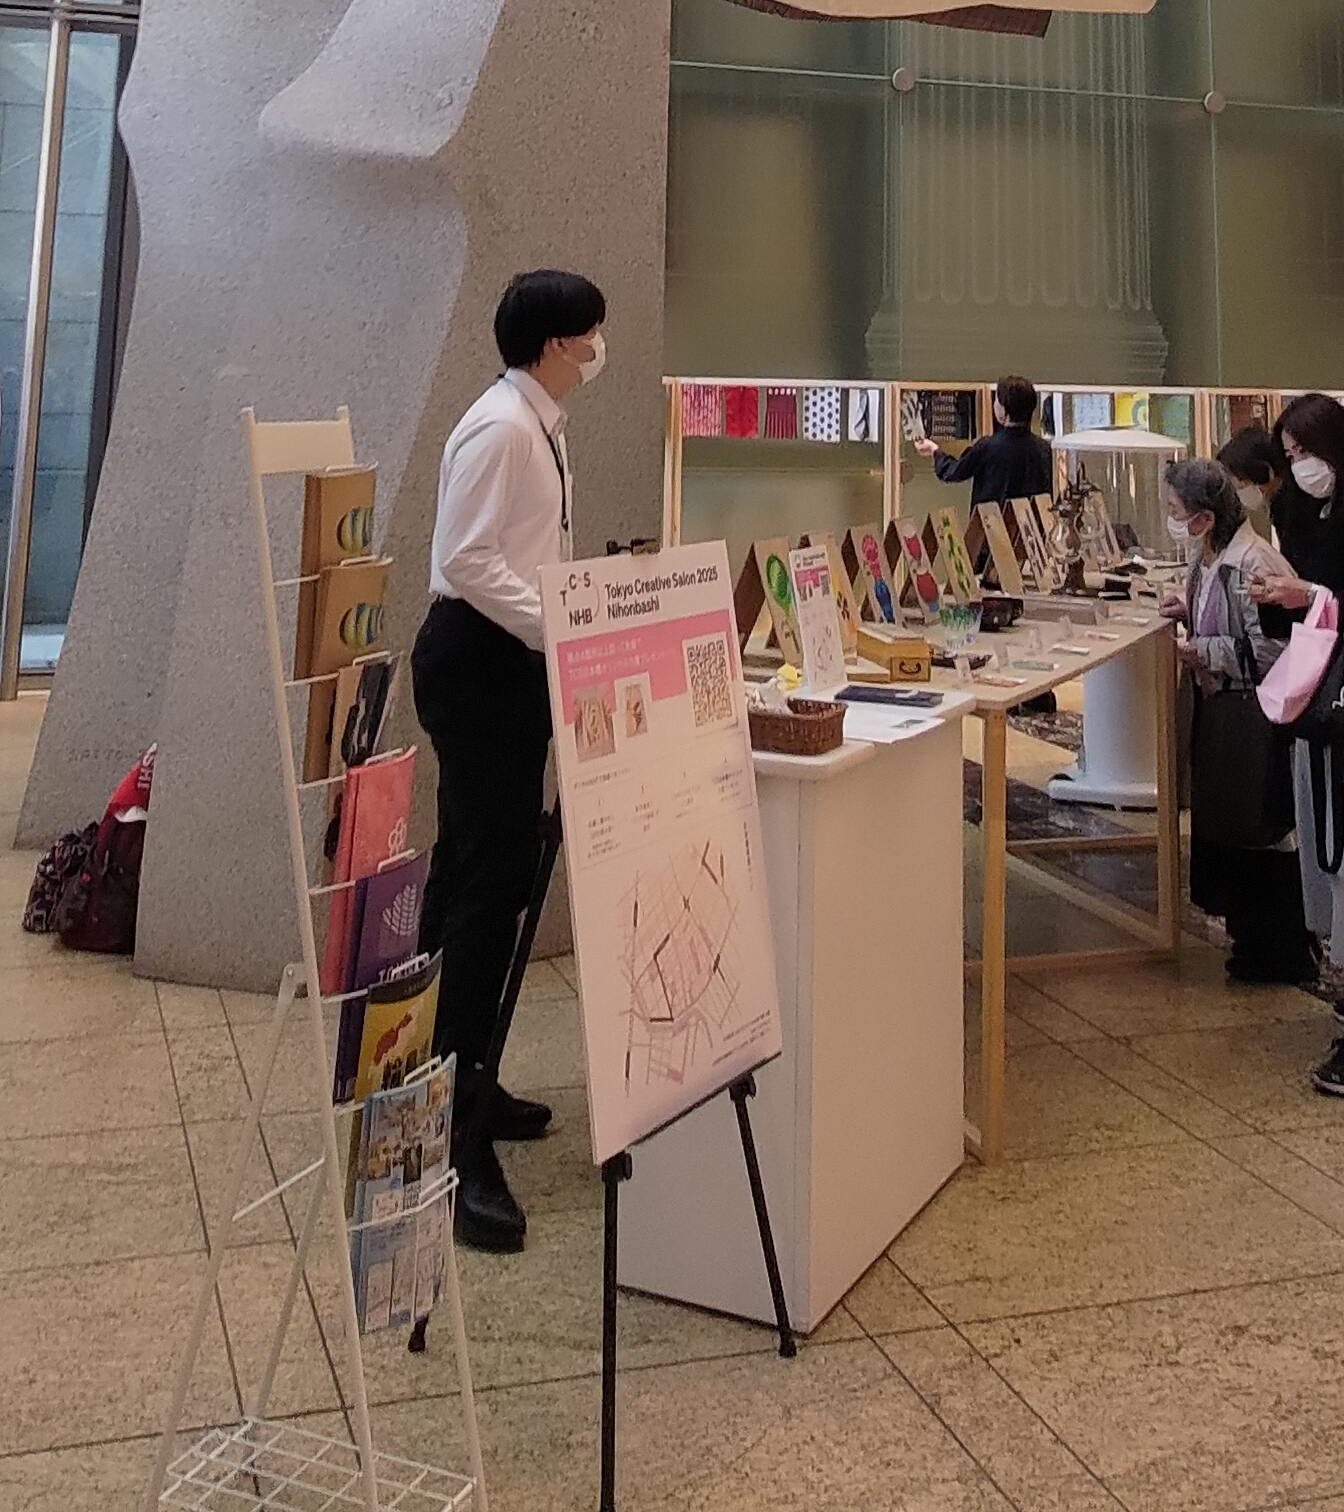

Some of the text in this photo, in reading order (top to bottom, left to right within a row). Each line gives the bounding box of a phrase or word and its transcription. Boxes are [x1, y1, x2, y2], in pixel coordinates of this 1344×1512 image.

[605, 580, 634, 601] Tokyo
[634, 573, 672, 595] Creative
[671, 570, 696, 588] Salon
[569, 608, 593, 627] NHB
[607, 595, 660, 620] Nihonbashi
